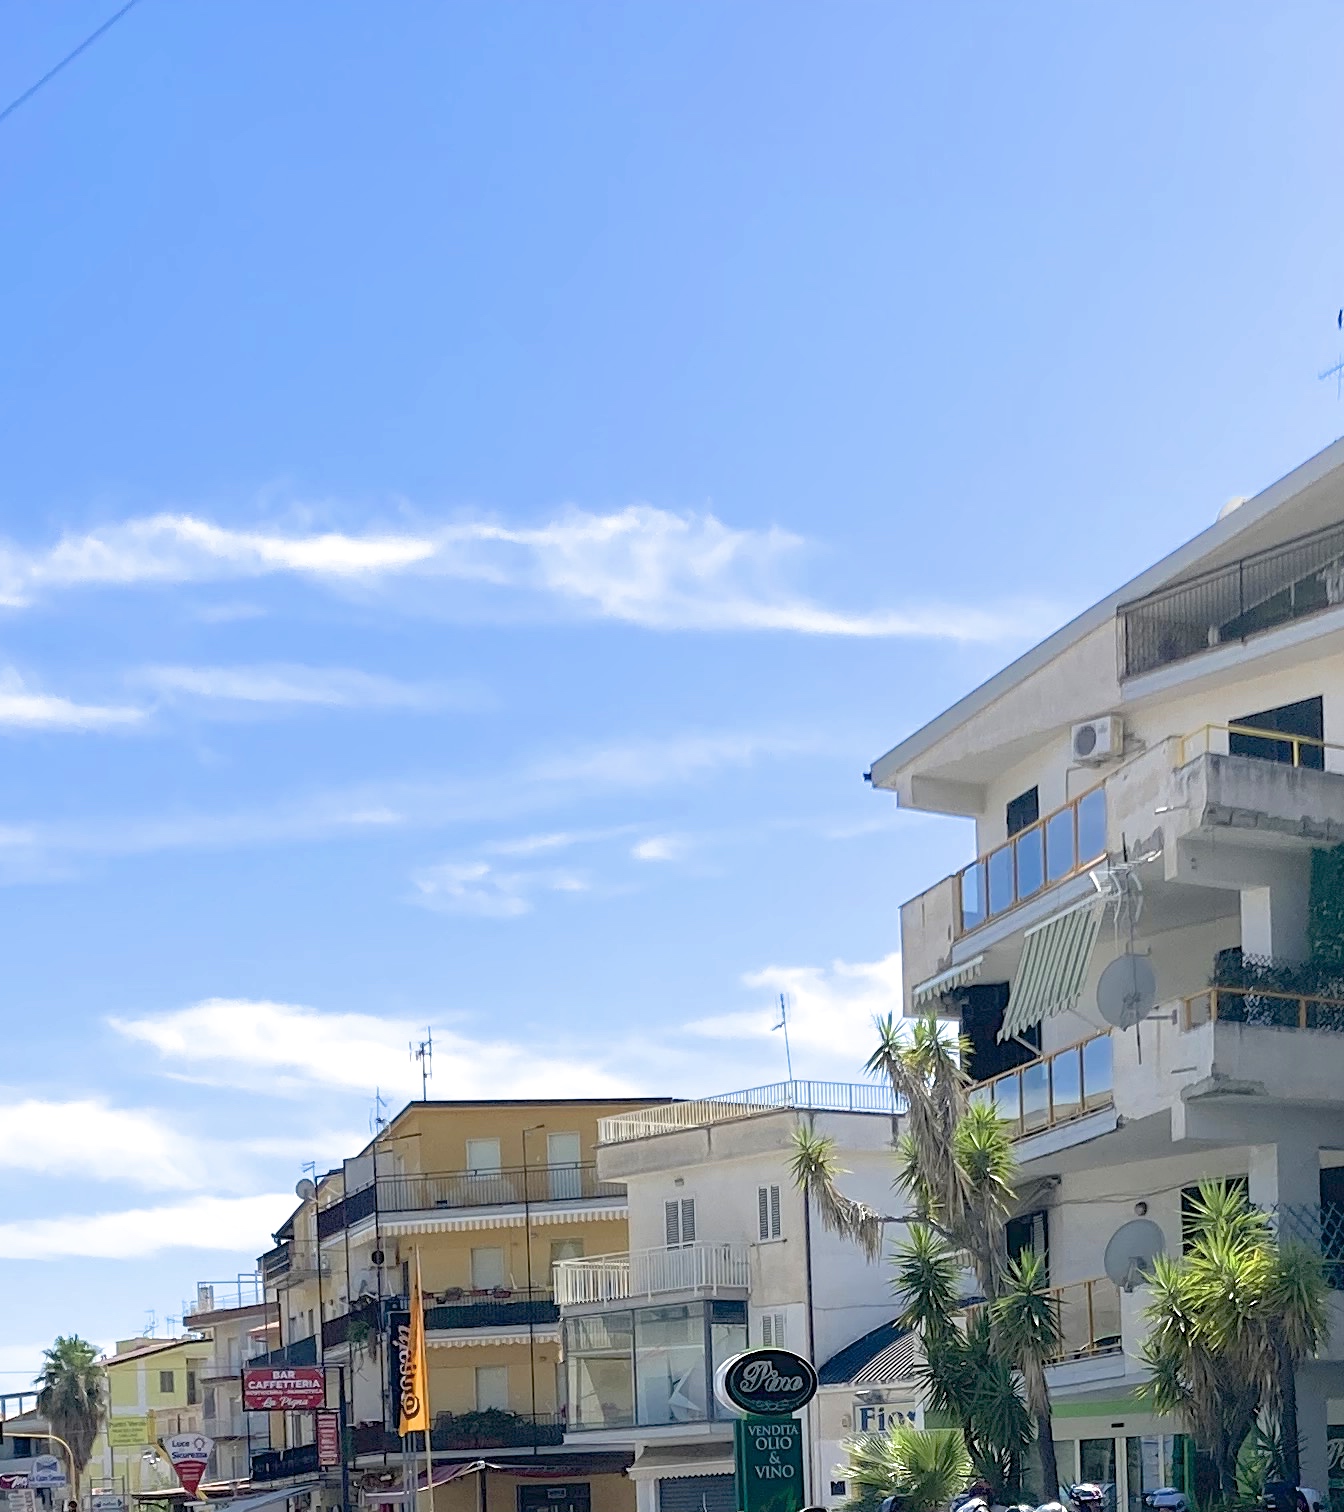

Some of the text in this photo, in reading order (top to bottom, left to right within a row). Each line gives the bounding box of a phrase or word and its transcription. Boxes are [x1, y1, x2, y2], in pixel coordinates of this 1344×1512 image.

[272, 1370, 296, 1380] BAR
[739, 1360, 804, 1393] Pino
[248, 1379, 320, 1390] CAFFETTERIA
[747, 1424, 800, 1436] VENDITA
[171, 1440, 190, 1448] Luce
[755, 1436, 793, 1451] OLIO
[768, 1451, 782, 1465] &
[754, 1464, 795, 1479] VINO
